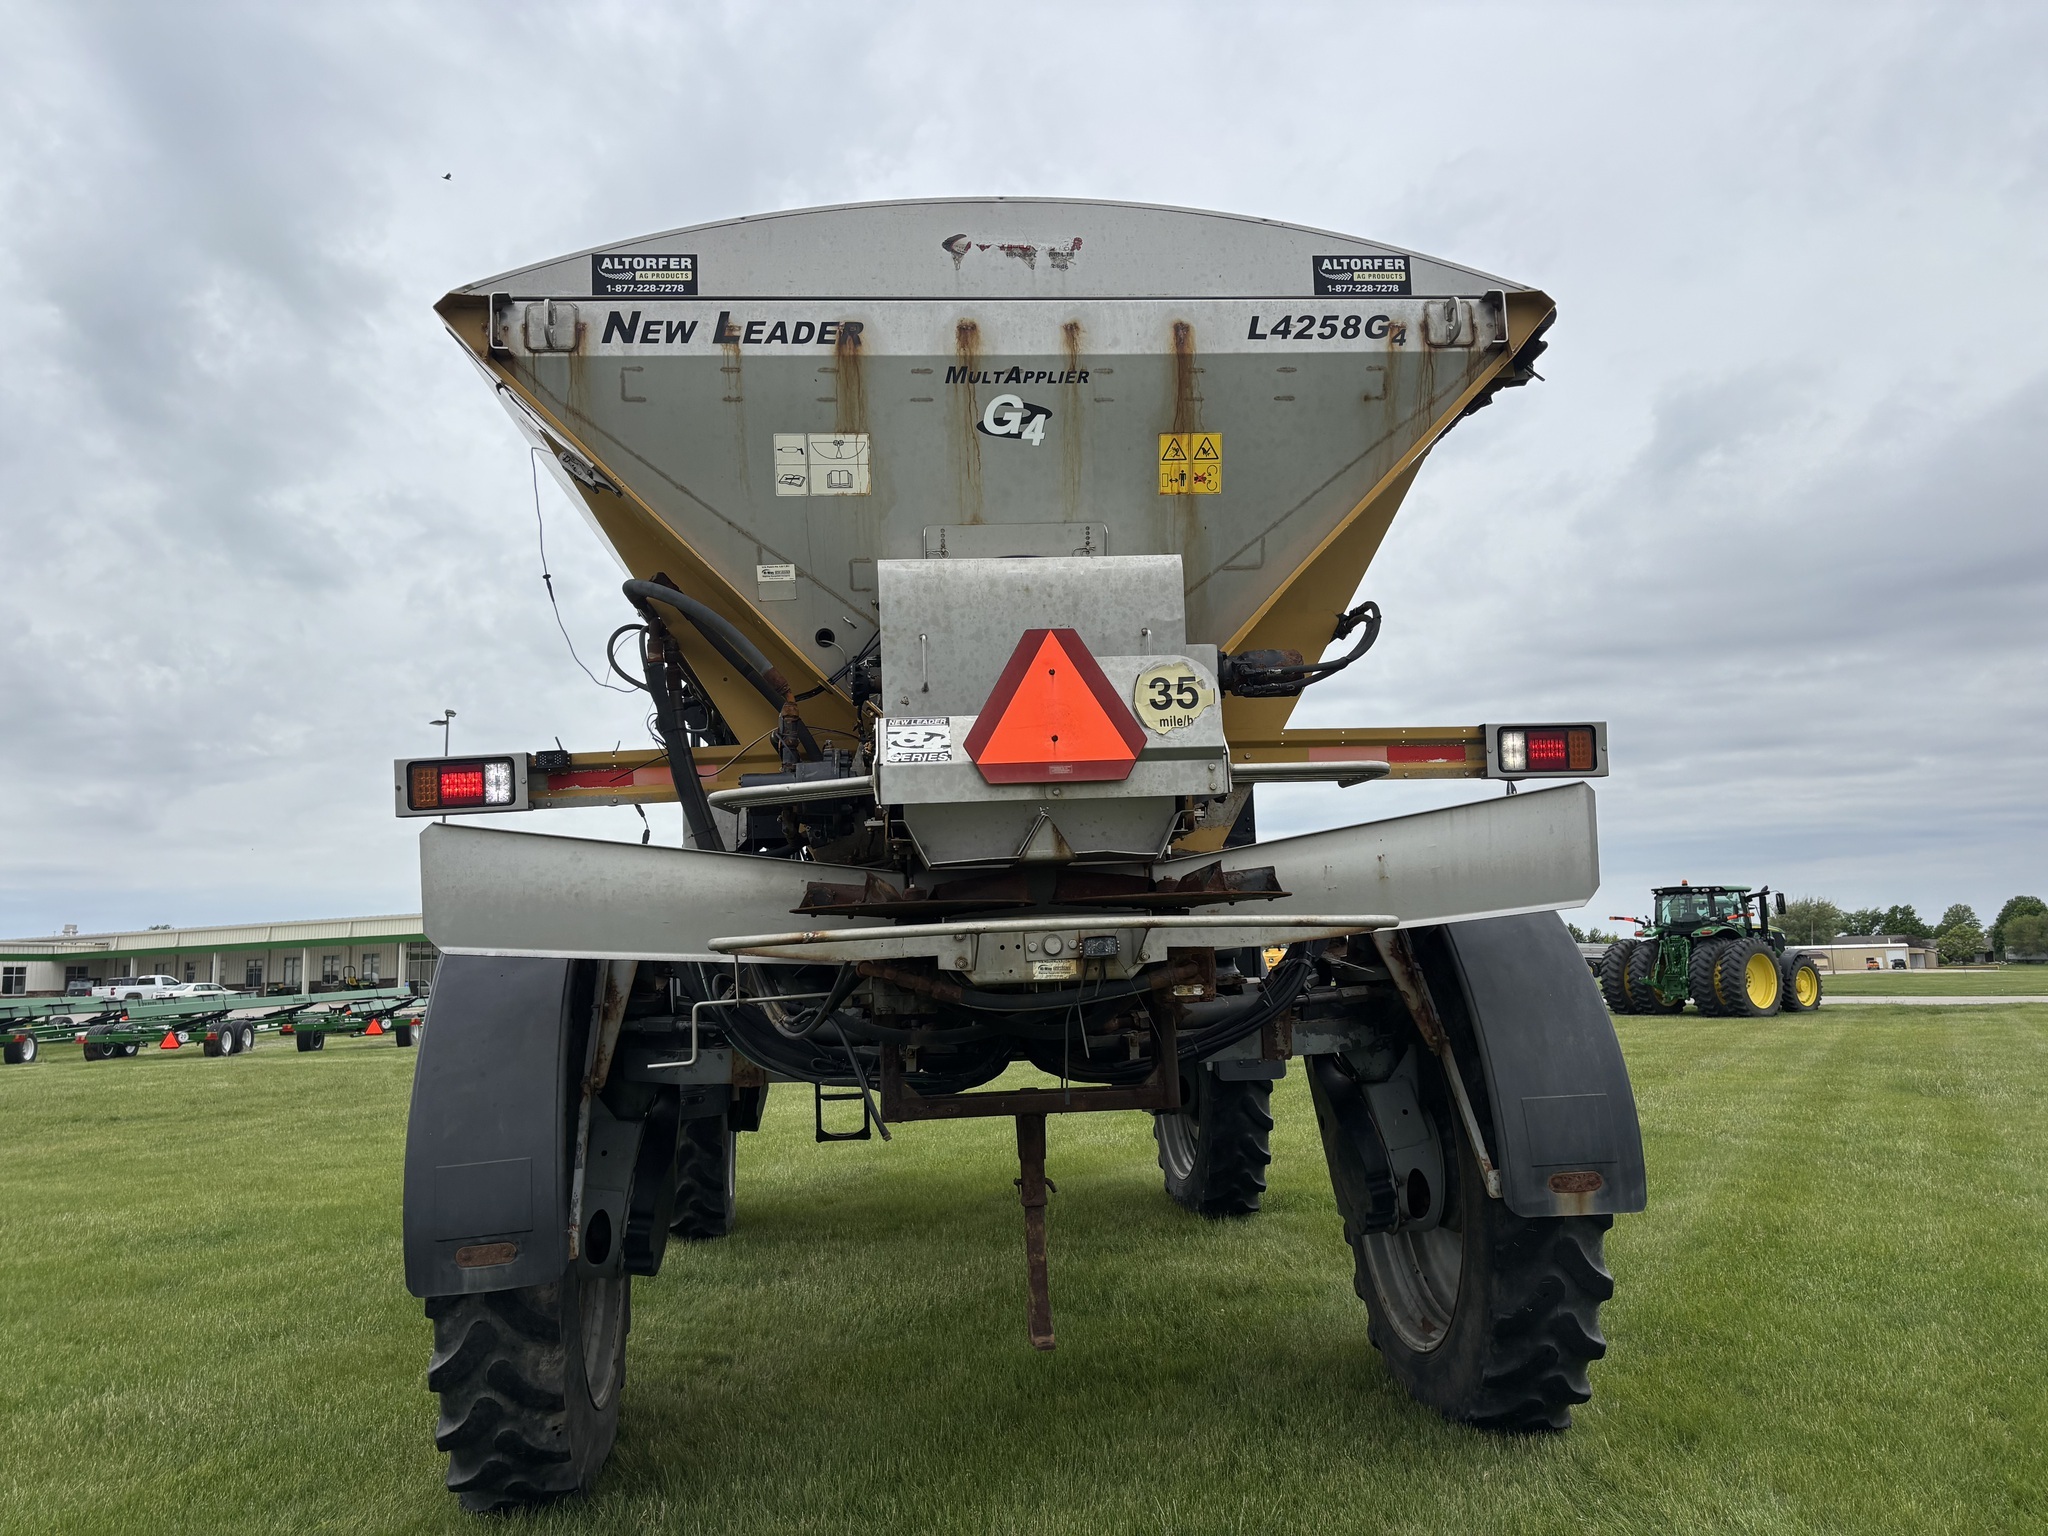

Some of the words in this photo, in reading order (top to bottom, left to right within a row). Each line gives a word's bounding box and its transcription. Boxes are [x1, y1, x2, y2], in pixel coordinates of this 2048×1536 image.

[601, 257, 692, 269] ALTORFER
[1321, 258, 1405, 270] ALTORFER
[606, 284, 684, 293] 1-877-228-7278
[1327, 284, 1399, 293] 1-877-228-7278
[601, 310, 698, 344] NEW
[712, 310, 864, 345] LEADER
[945, 366, 1090, 384] MULTAPPLIER
[983, 393, 1047, 447] G4
[1148, 676, 1199, 710] 35
[888, 718, 909, 726] NEW
[911, 718, 947, 726] LEADER
[889, 751, 949, 762] SERIES
